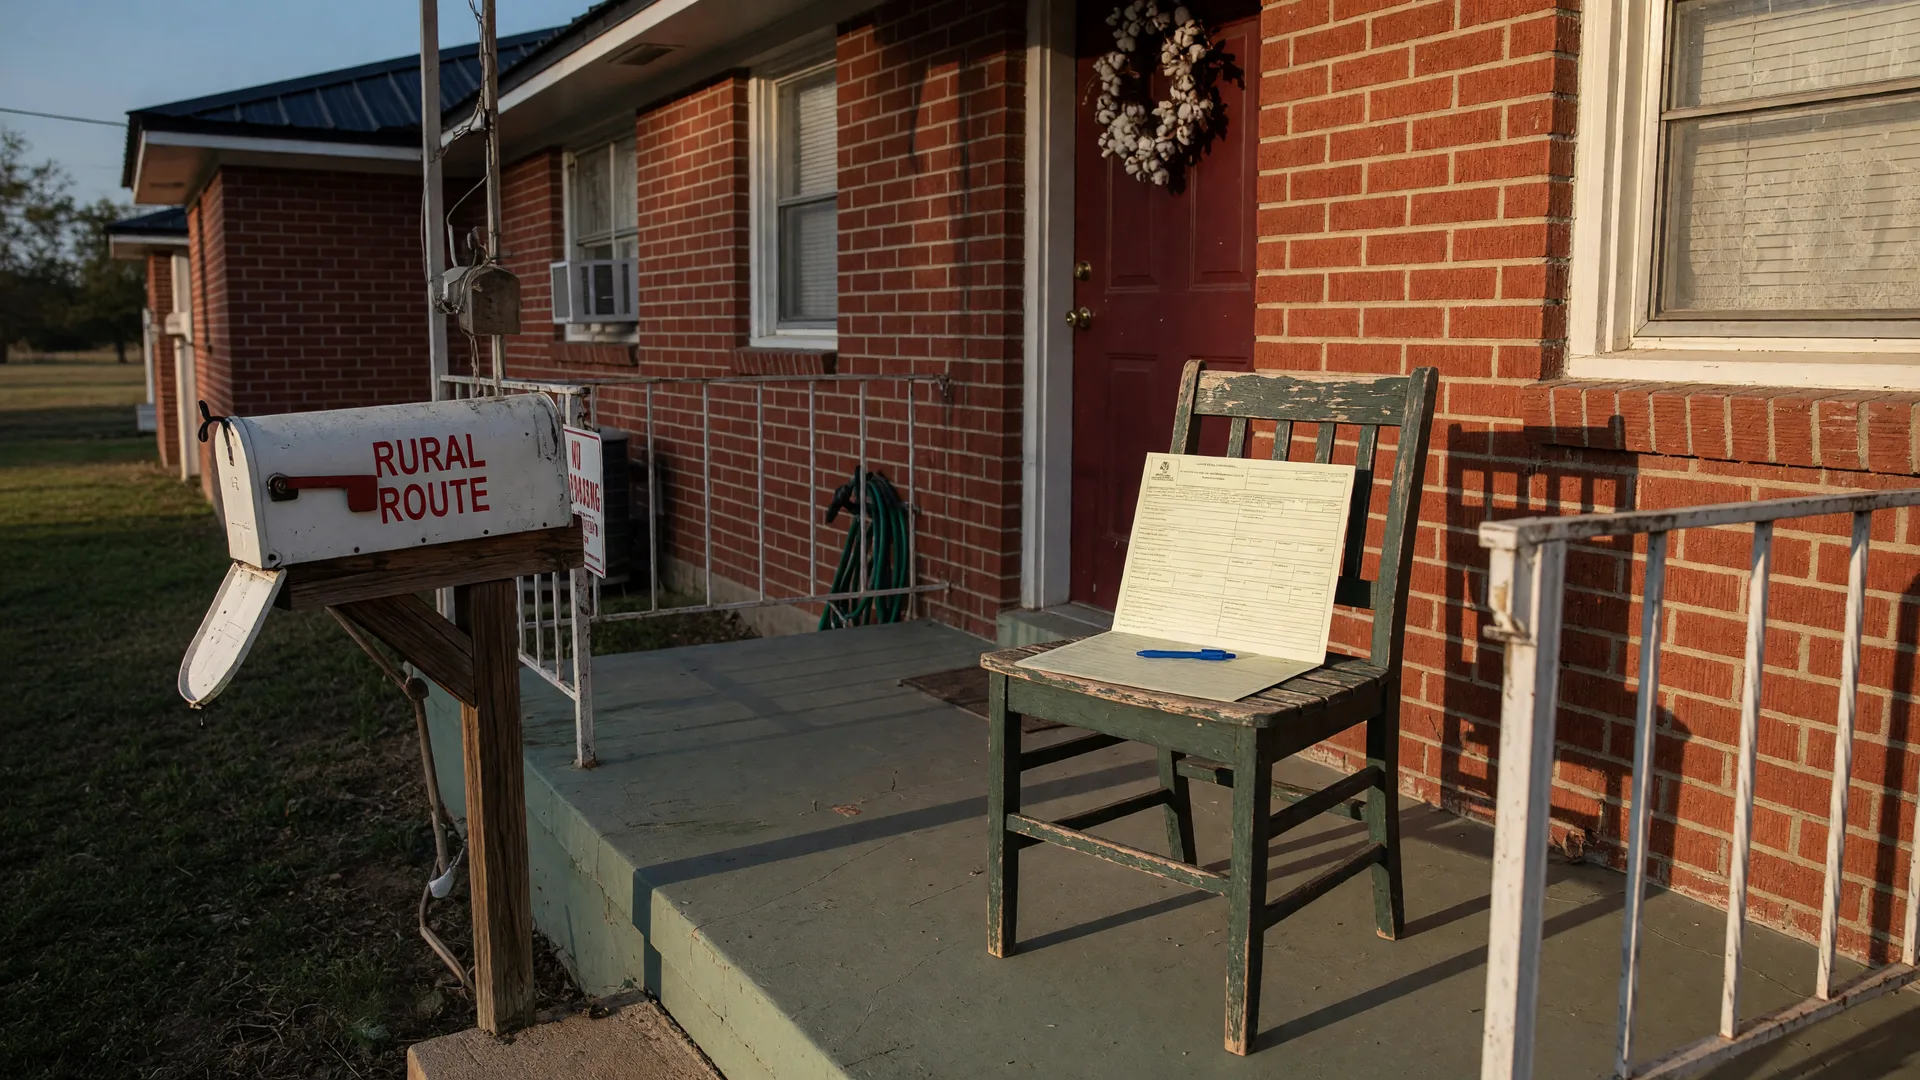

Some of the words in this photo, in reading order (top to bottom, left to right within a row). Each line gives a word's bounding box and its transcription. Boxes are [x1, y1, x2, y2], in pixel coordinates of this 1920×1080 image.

[372, 433, 487, 478] RURAL
[571, 440, 581, 471] NO
[379, 476, 490, 524] ROUTE
